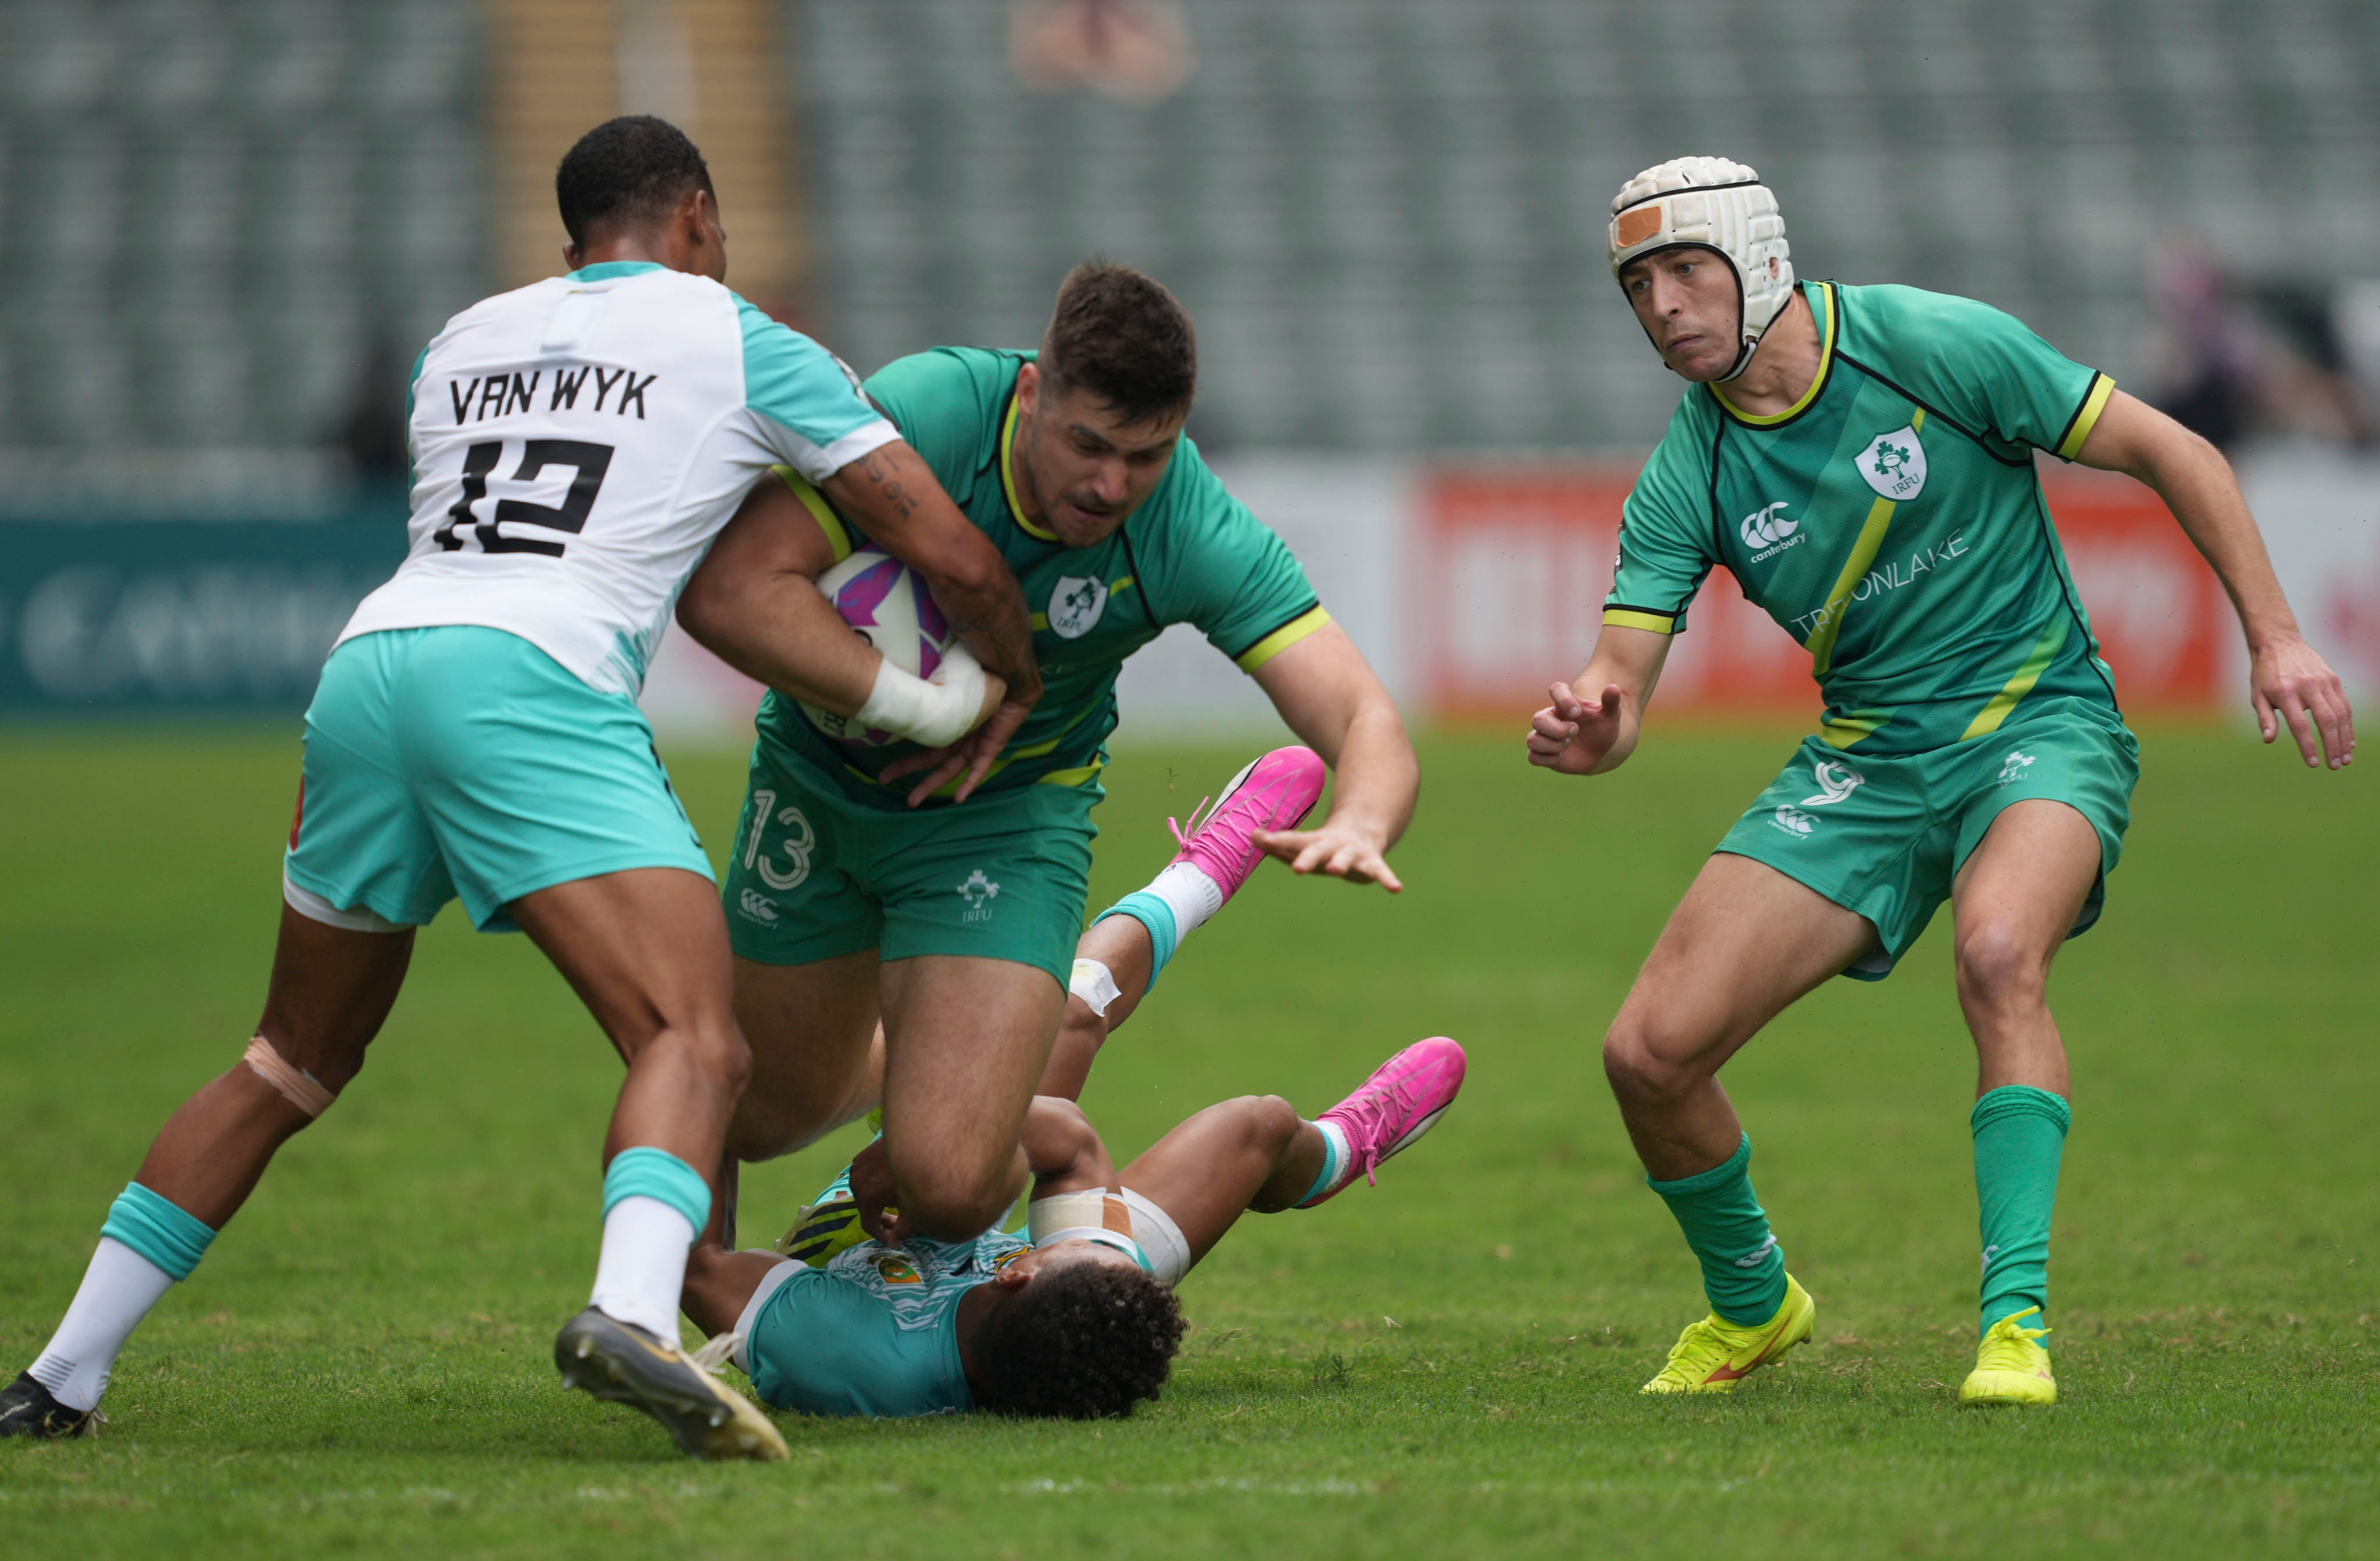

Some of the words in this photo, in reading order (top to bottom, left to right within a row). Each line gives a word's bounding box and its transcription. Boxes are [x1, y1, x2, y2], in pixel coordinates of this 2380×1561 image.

[450, 370, 541, 426] VAN
[549, 366, 658, 420] WYK
[432, 438, 615, 558] 12
[1892, 473, 1920, 495] IRFU
[1750, 533, 1806, 564] cantebury
[744, 789, 815, 891] 13
[1767, 820, 1809, 840] canterbury
[962, 909, 993, 923] IRFU
